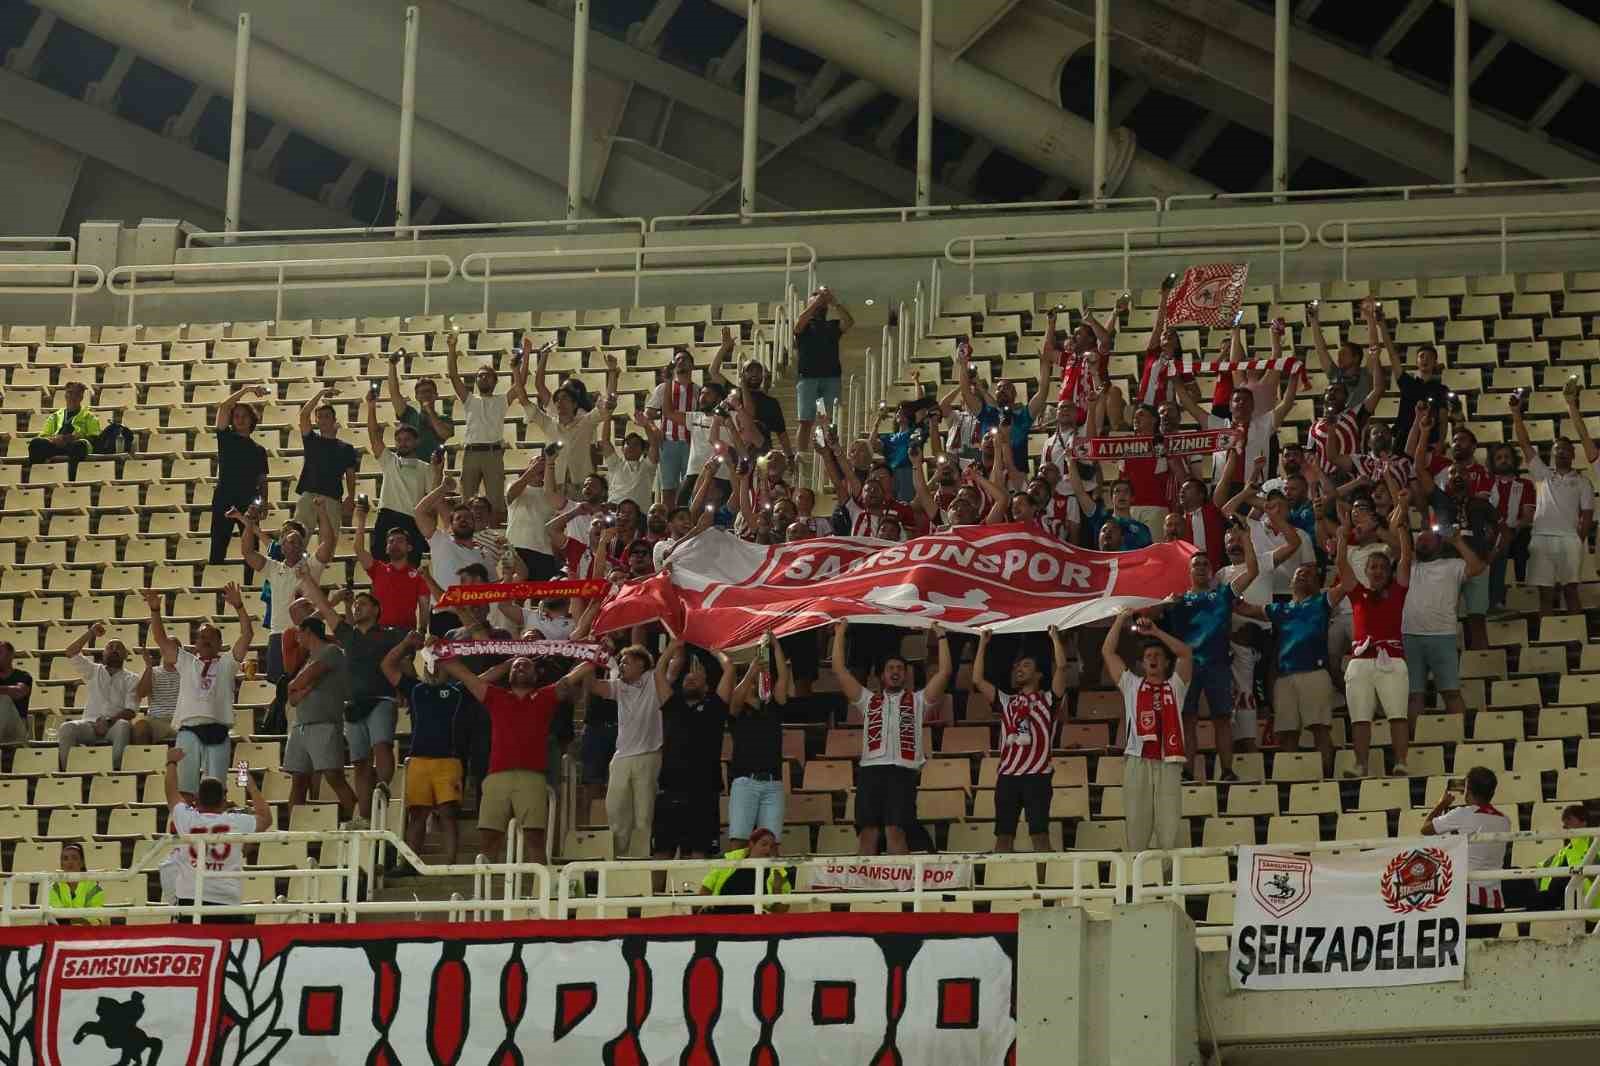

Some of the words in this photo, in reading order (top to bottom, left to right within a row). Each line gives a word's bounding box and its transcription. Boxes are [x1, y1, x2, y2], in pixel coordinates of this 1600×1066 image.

[785, 543, 1093, 588] SAMSUNSPOR
[848, 864, 954, 884] SAMSUNPOR
[64, 956, 202, 977] SAMSUNSPOR
[1236, 917, 1460, 984] ŞEHZADELER
